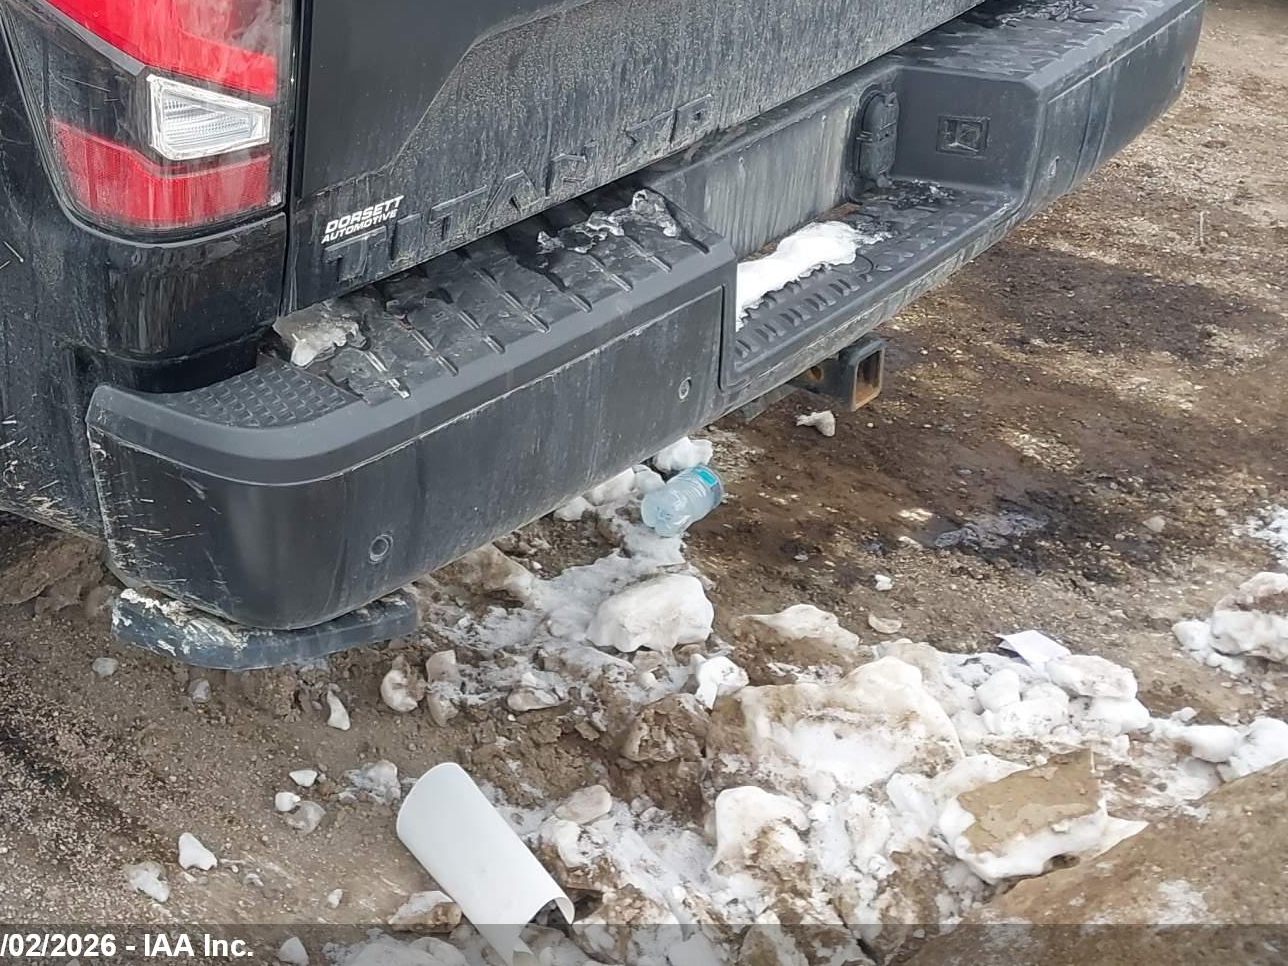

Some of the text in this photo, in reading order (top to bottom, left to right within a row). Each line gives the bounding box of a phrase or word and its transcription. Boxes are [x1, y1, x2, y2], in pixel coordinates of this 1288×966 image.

[323, 93, 713, 281] TITAN XD
[320, 208, 399, 244] AUTOMOTIVE
[324, 194, 405, 234] DORSETT
